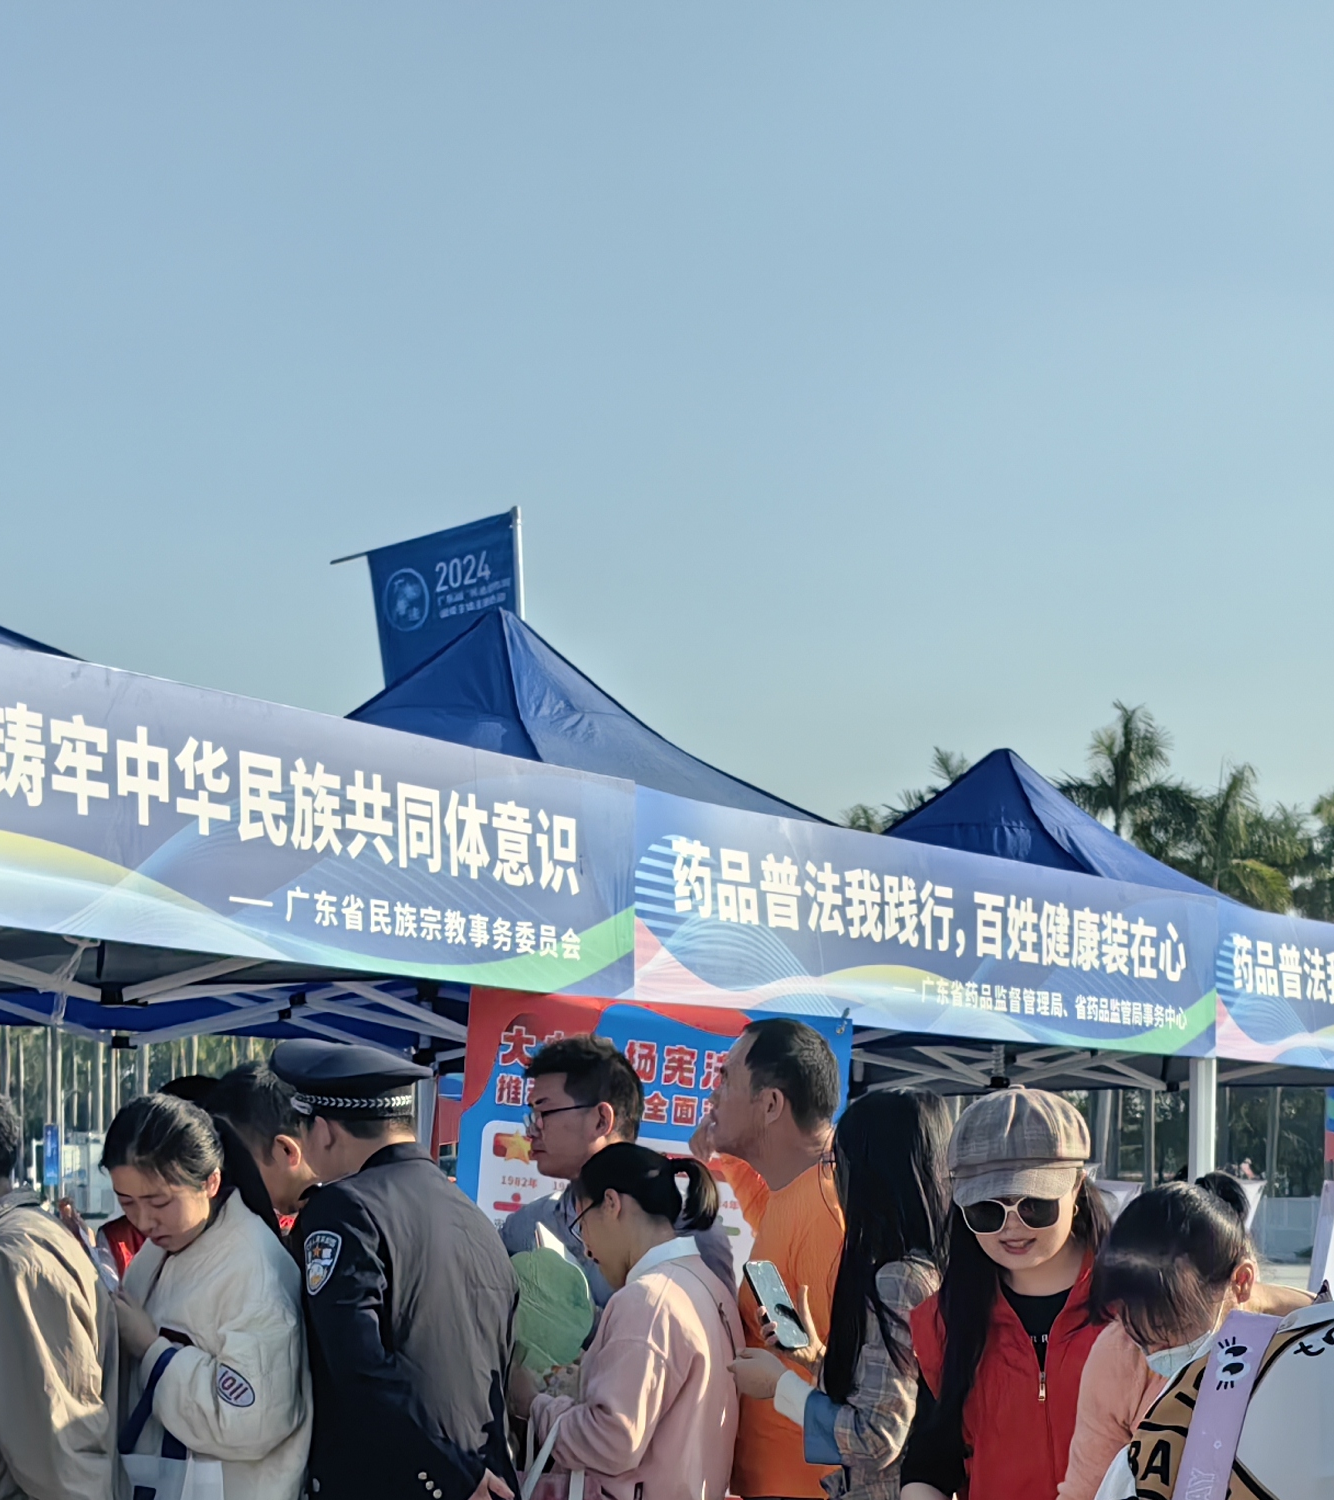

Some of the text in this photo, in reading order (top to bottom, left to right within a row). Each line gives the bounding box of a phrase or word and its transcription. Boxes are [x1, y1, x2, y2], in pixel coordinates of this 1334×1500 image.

[435, 551, 492, 592] 2024
[285, 886, 581, 962] 广东省民族宗教事务委员会
[672, 836, 1186, 983] 药品普法我践行，百姓健康装在心
